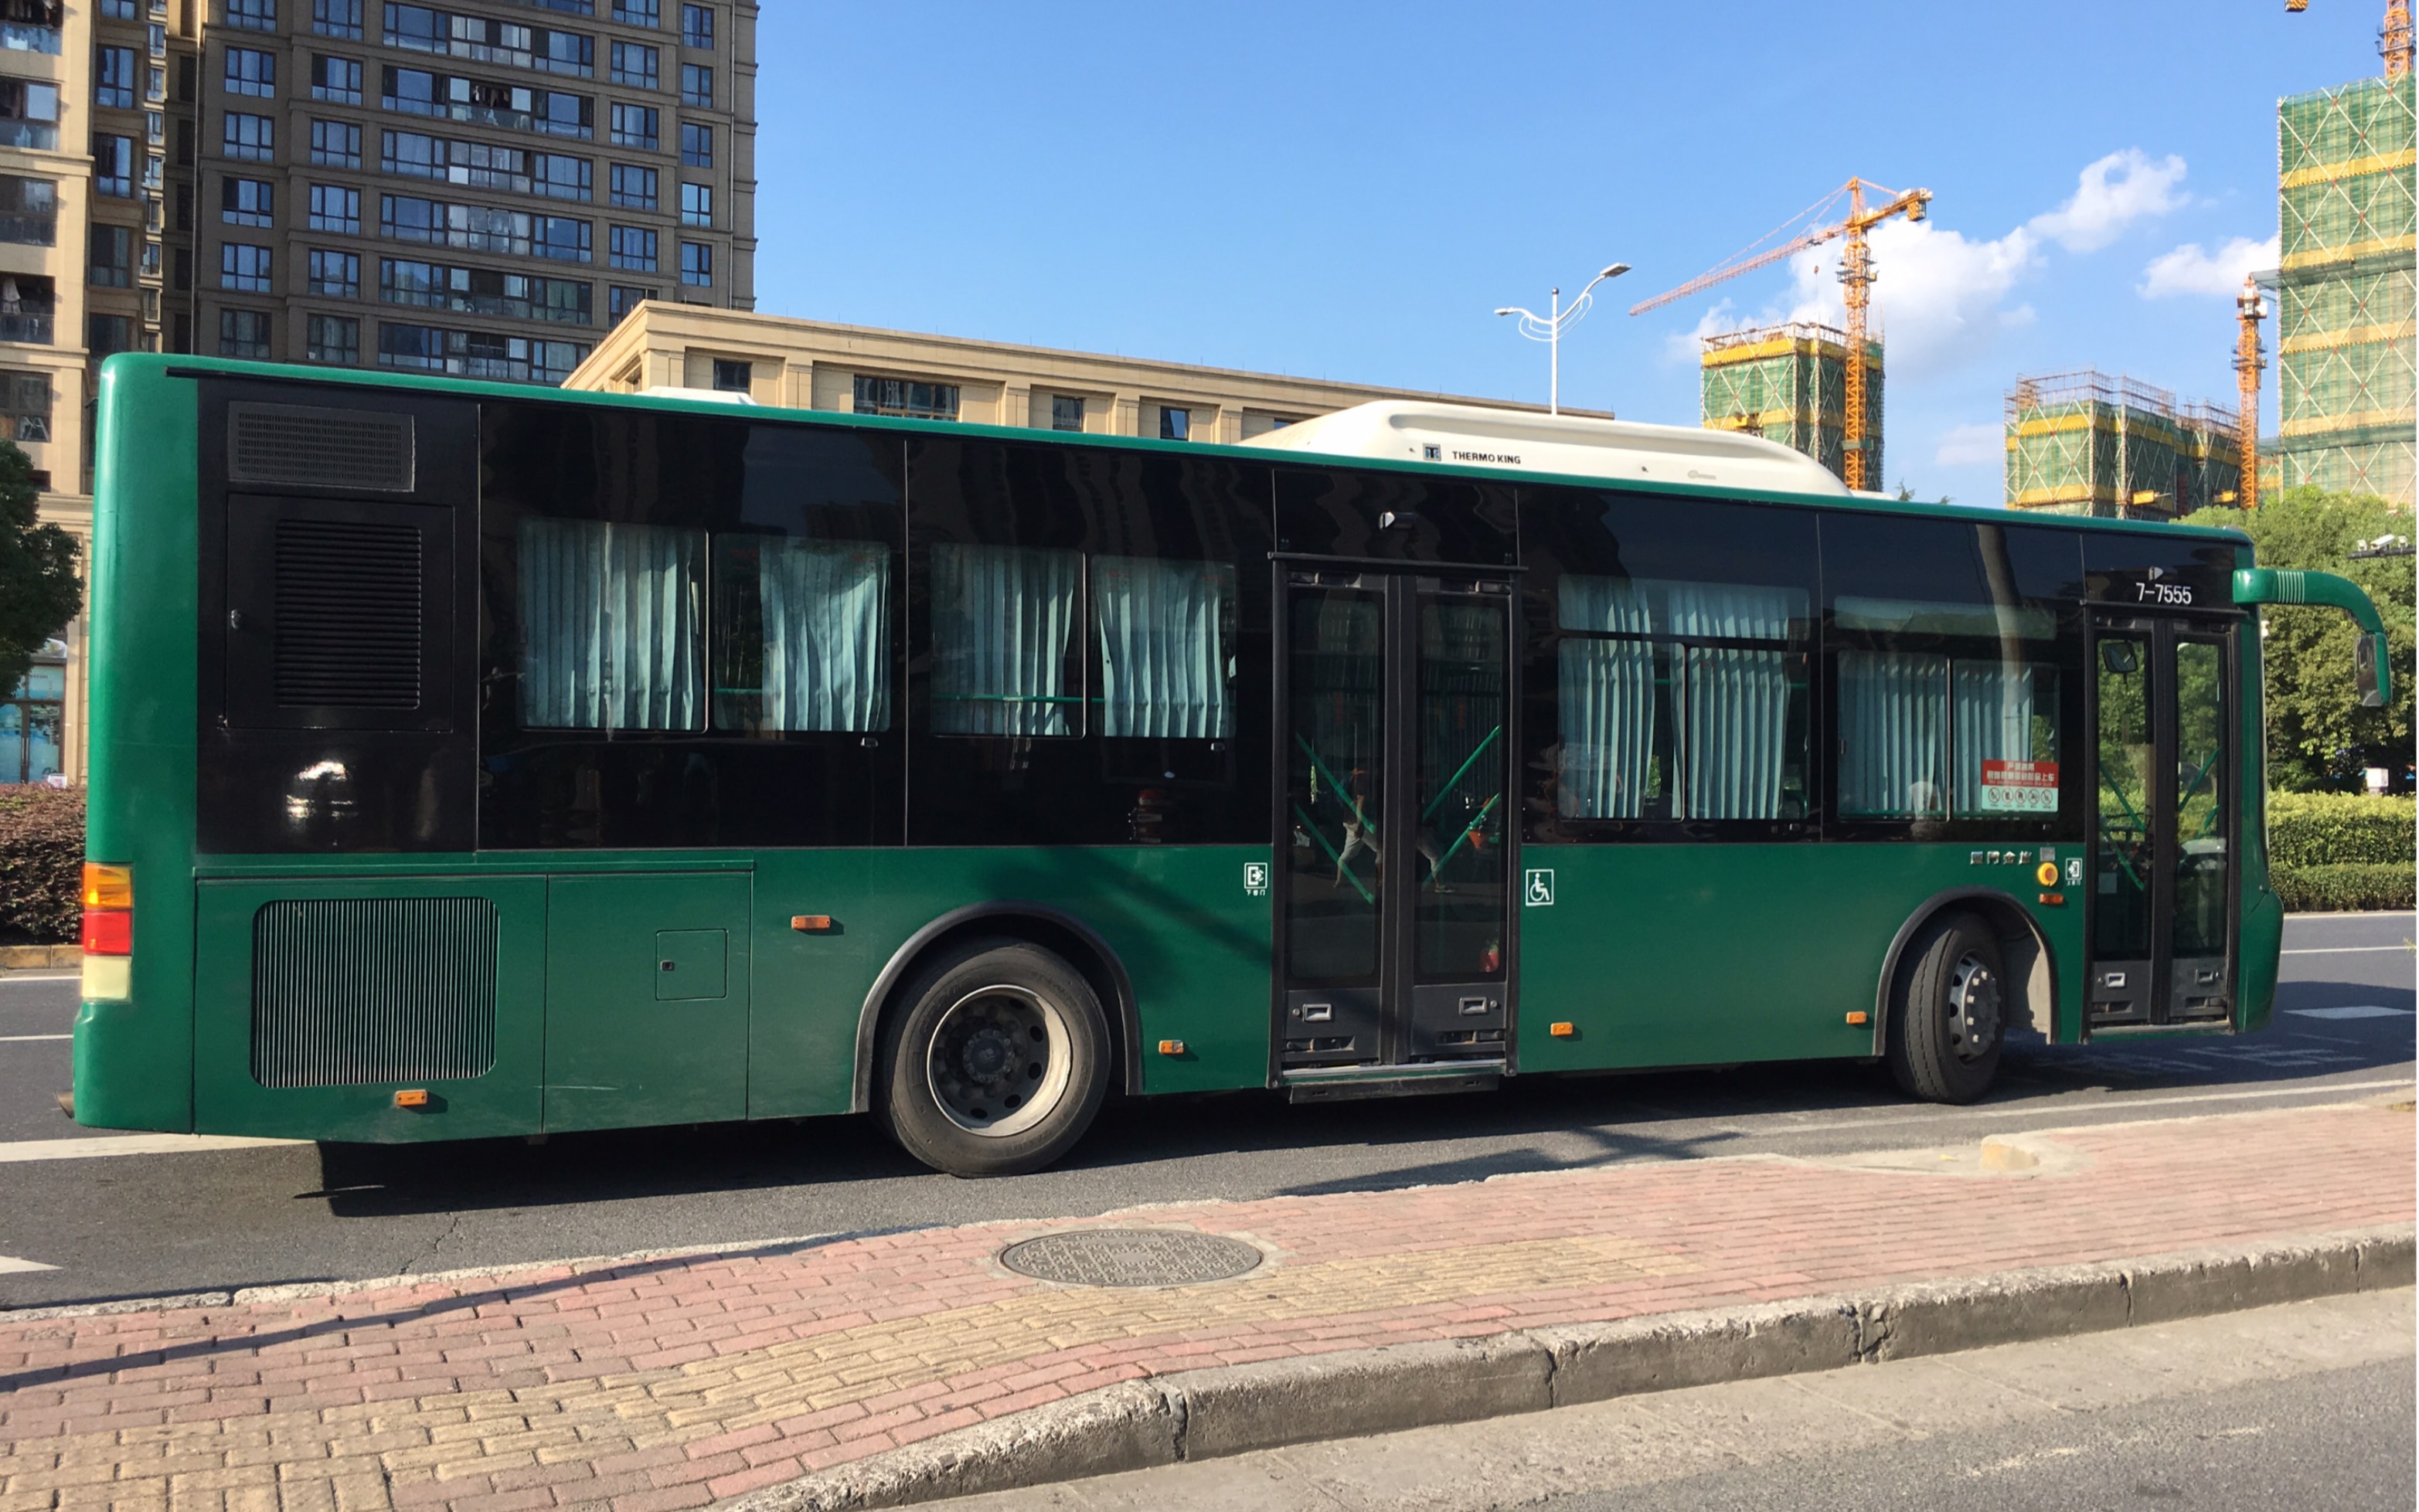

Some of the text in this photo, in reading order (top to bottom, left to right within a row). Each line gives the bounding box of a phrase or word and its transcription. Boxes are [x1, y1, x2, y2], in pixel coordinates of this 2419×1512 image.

[1452, 451, 1521, 464] THERMO KING
[2135, 582, 2193, 604] 7-7555
